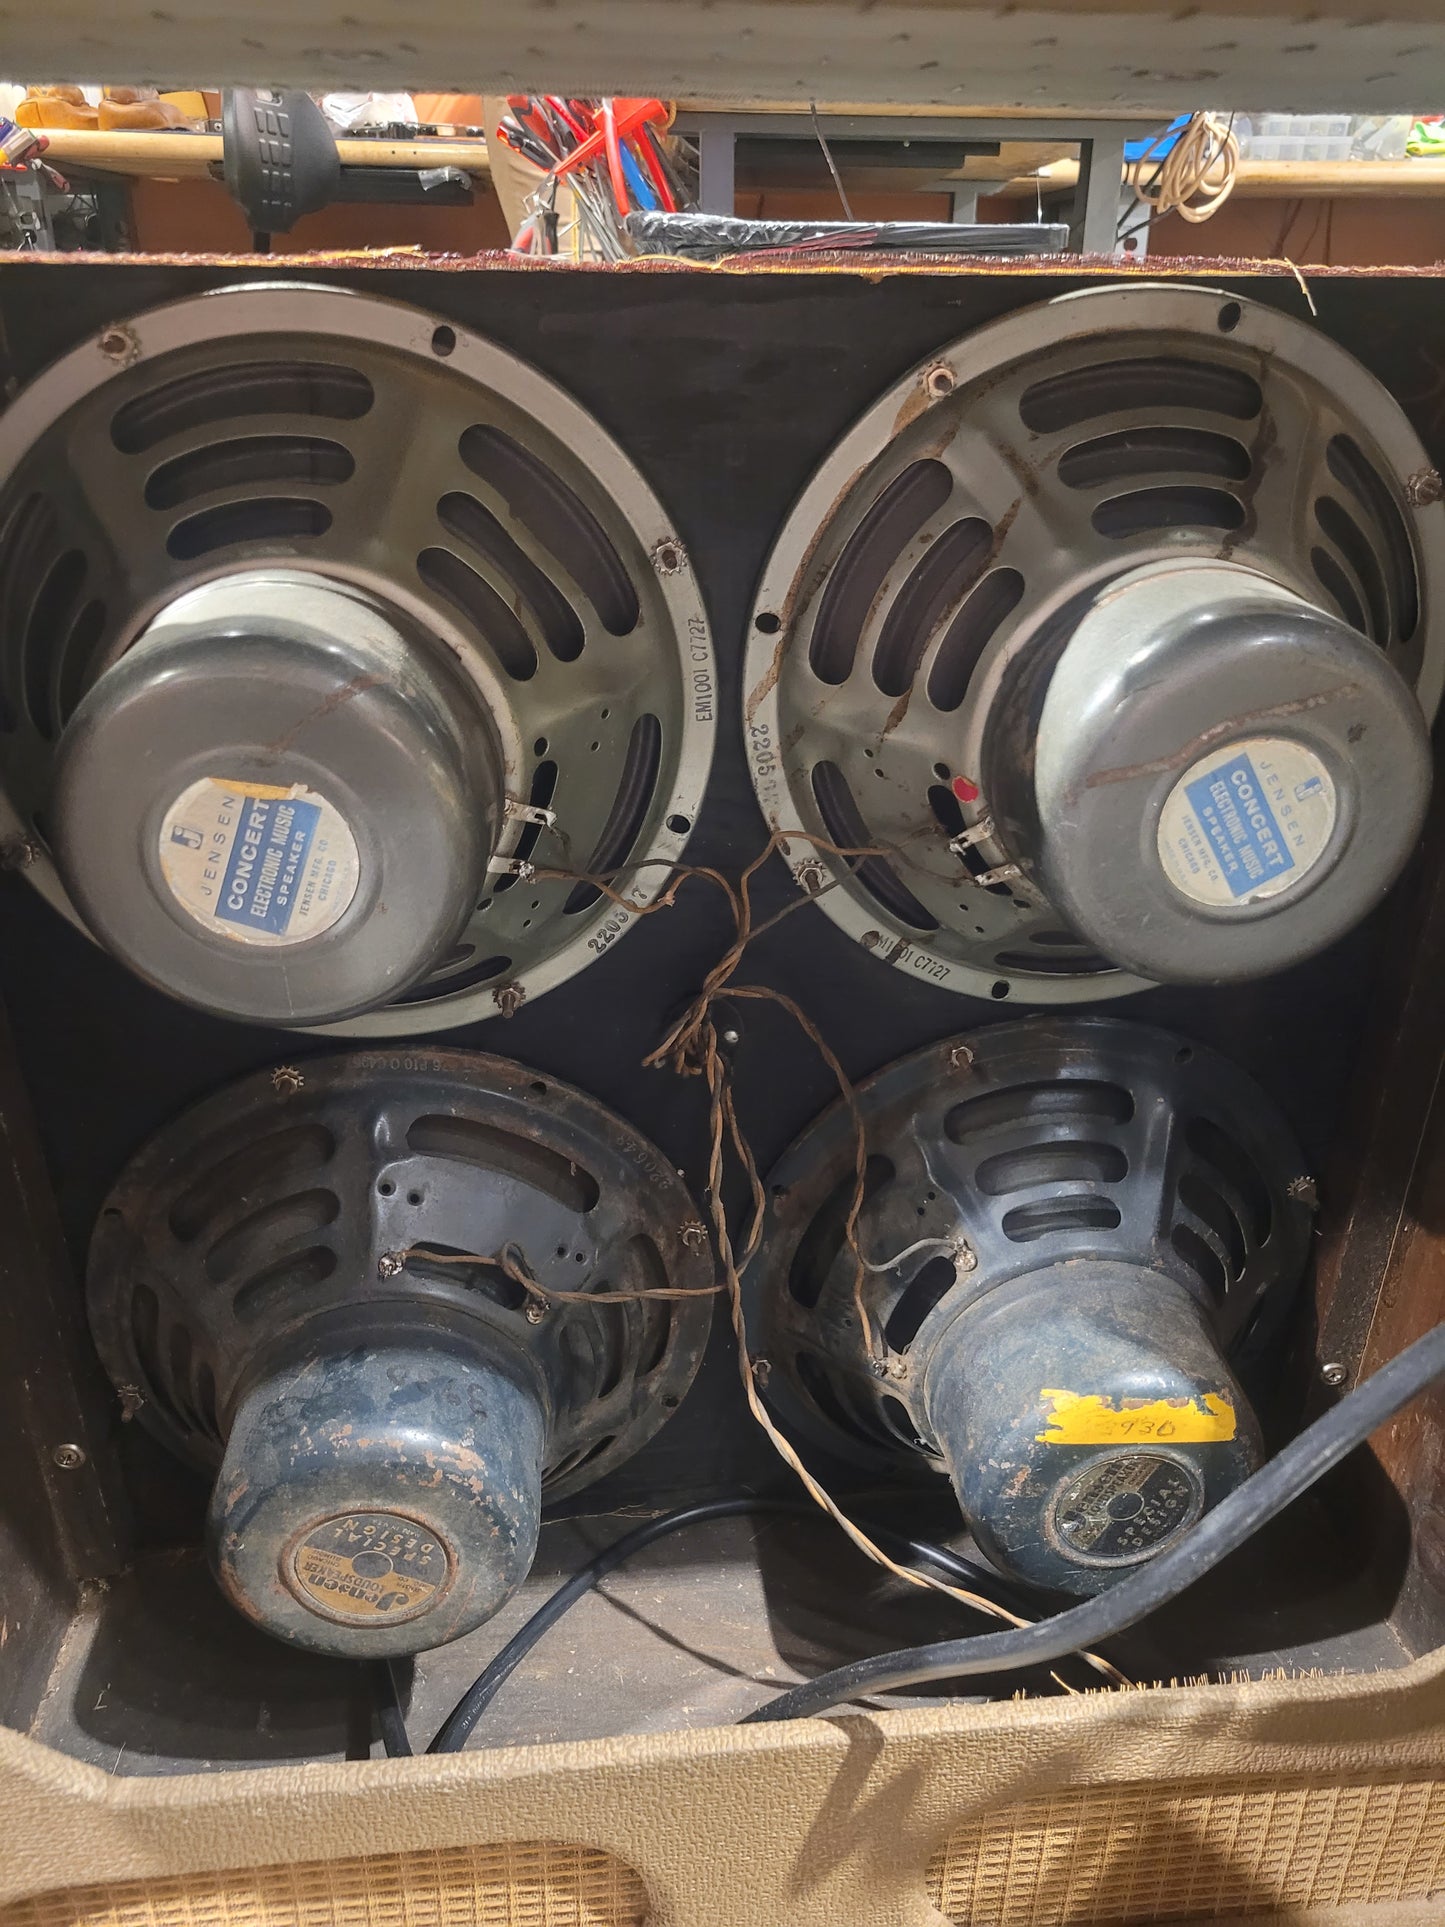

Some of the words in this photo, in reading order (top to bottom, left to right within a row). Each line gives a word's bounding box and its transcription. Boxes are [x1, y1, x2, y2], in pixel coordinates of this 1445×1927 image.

[688, 618, 708, 662] C7727
[694, 668, 713, 722] EM1001
[1208, 779, 1249, 845] ELECTRONIC
[1238, 843, 1266, 880] MUSIC
[1230, 769, 1285, 867] CONCERT
[1259, 760, 1306, 847] JENSEN
[201, 796, 236, 897] JENSEN
[226, 797, 270, 911] CONCERT
[250, 846, 285, 919] ELECTRONIC
[270, 804, 296, 846] MUSIC
[276, 830, 307, 907] SPEAKER
[1201, 806, 1240, 874] SPEAKER
[298, 880, 317, 917] JENSEN
[317, 859, 338, 902] CHICAGO
[333, 1527, 432, 1565] SPECIAL
[342, 1518, 435, 1553] DESIGN
[303, 1561, 385, 1594] LOUDSPEAKER
[308, 1573, 410, 1611] Jensen
